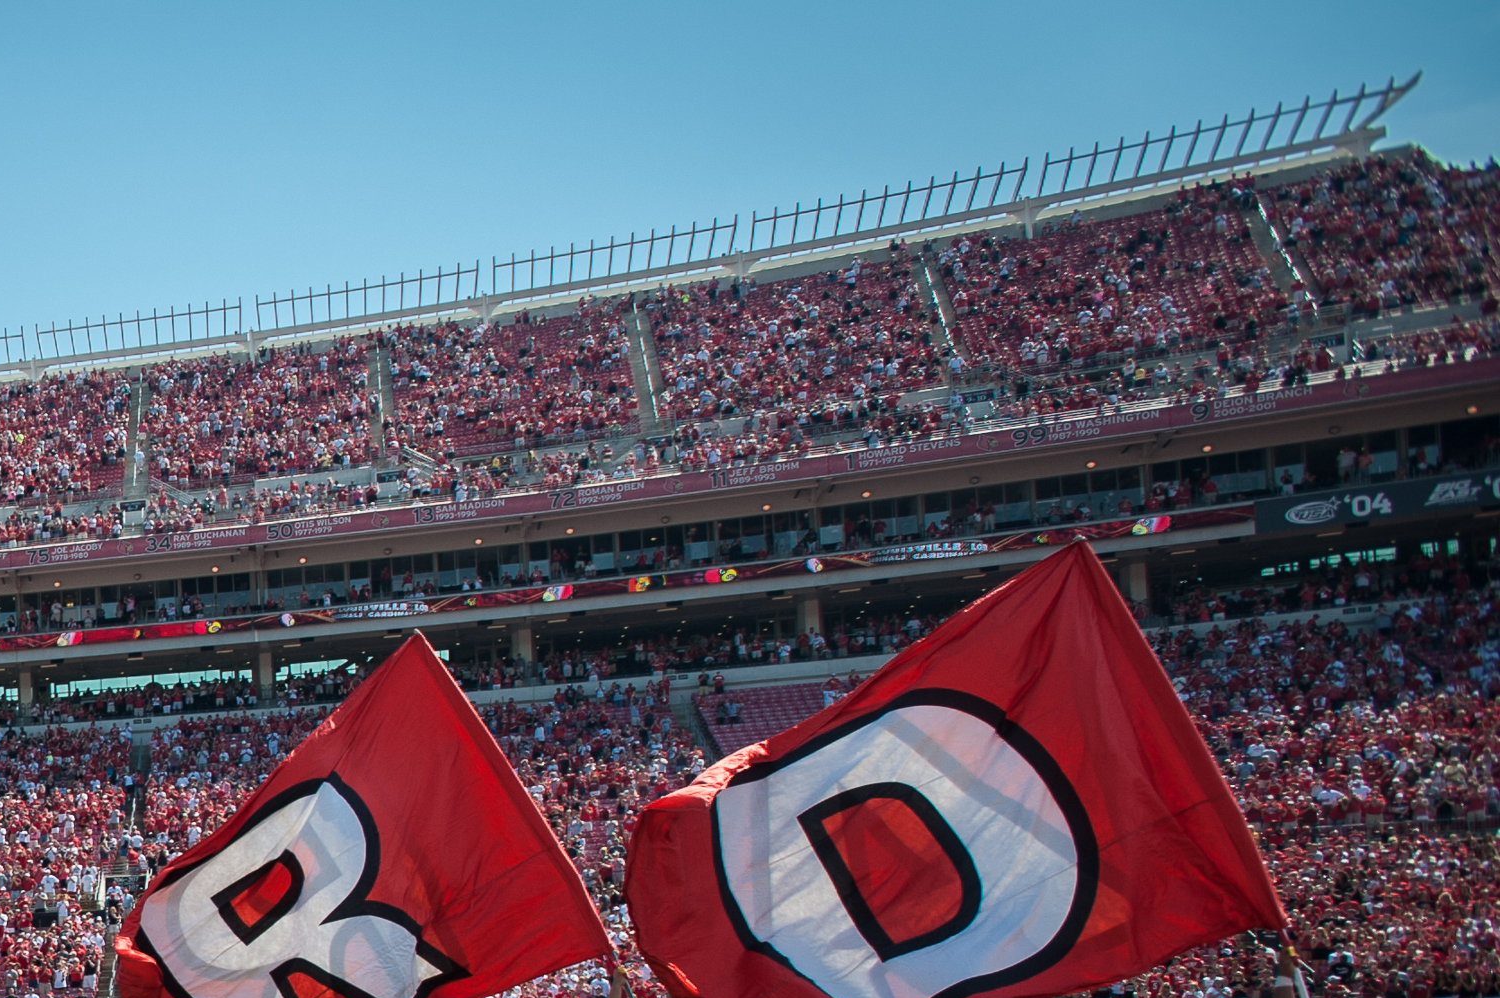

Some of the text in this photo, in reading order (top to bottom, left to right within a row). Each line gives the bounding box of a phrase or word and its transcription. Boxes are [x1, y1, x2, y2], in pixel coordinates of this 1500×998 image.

[1190, 386, 1313, 421] 9 DEION BRANCH
[1011, 410, 1159, 447] 99 TED WASHINGTON
[844, 439, 961, 470] 1 HOWARD STEVENS
[709, 462, 799, 488] 11 JEFF BROHM
[547, 482, 644, 509] 72 ROMAN OBEN
[1344, 493, 1392, 517] '04
[412, 500, 505, 523] 13 SAM MADISON
[145, 529, 245, 552] 34 RAY BUCHANAN
[266, 516, 351, 540] 50 OTIS WILSON
[26, 542, 103, 564] 75 JOE JACOBY
